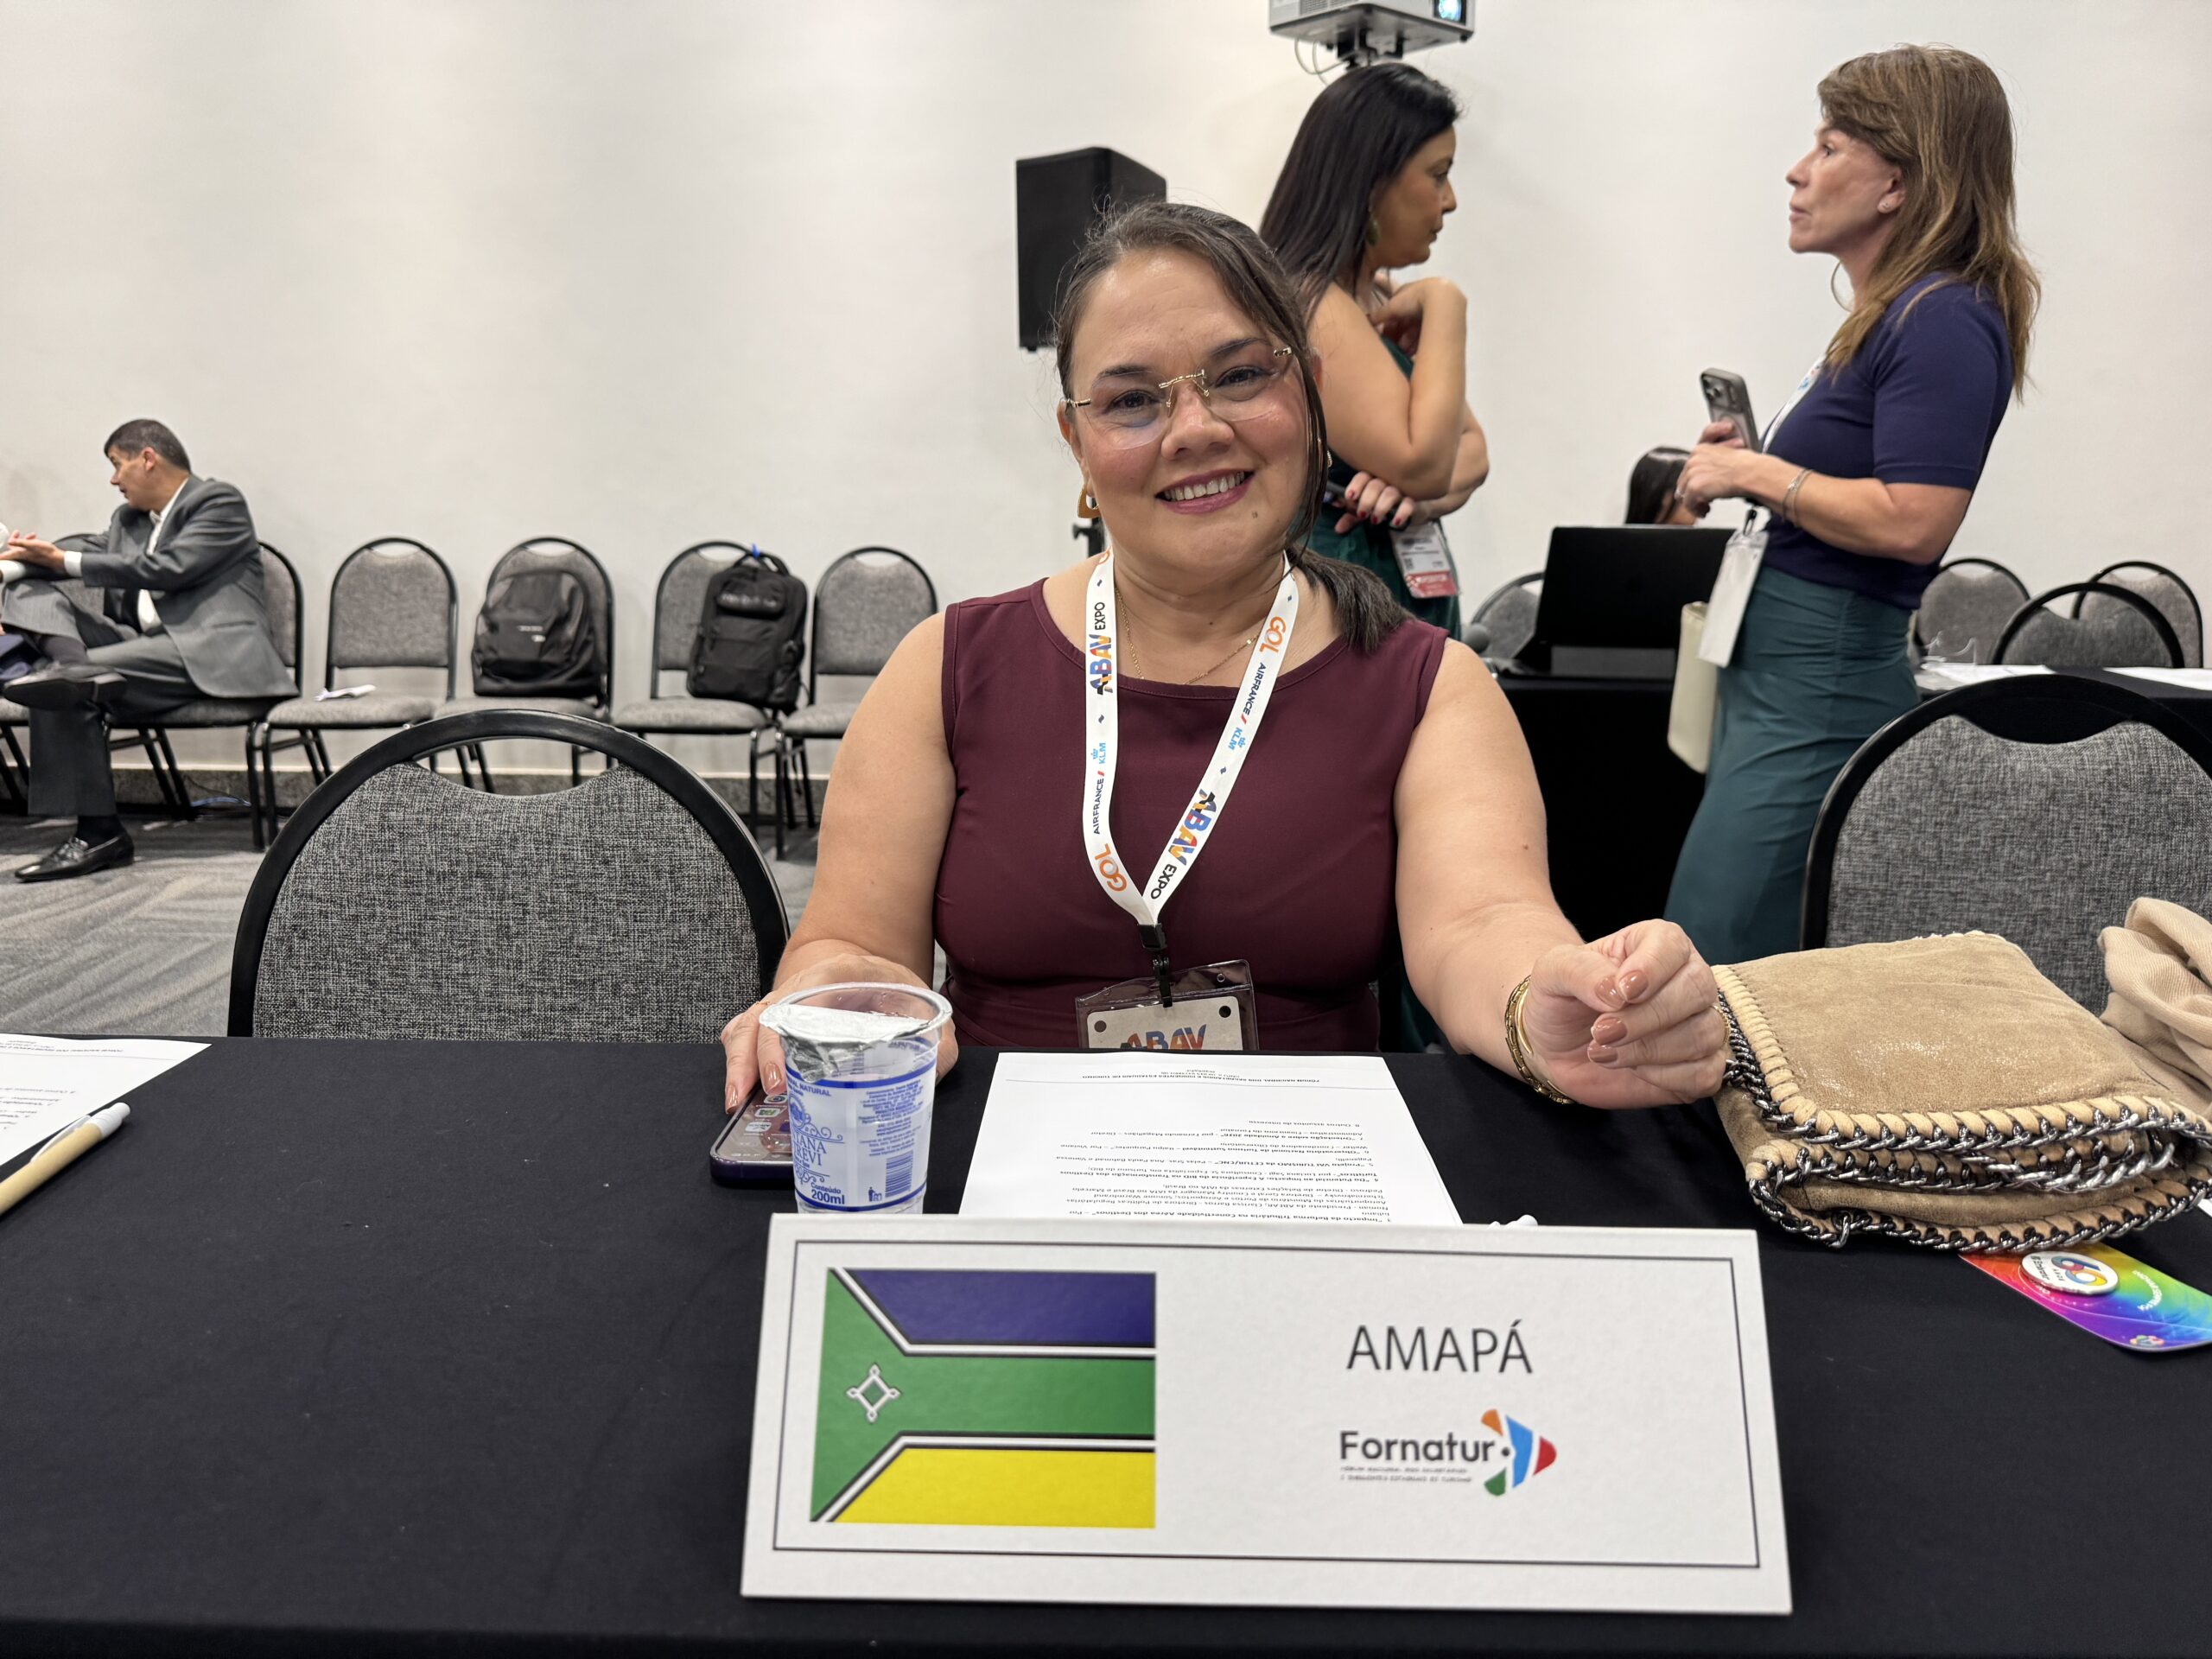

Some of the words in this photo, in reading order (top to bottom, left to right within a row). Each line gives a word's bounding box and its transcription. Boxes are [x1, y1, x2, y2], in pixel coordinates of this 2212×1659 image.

[1094, 602, 1105, 630] EXPO
[1260, 616, 1287, 653] GOL
[1089, 633, 1113, 696] ABAV
[1243, 662, 1267, 715] AIRFRANCE
[1228, 727, 1243, 750] KLM
[1093, 778, 1104, 835] AIRFRANCE
[1168, 789, 1217, 866] ABAV
[1095, 843, 1128, 892] GOL
[1151, 864, 1177, 899] EXPO
[799, 1083, 832, 1097] NATURAL
[810, 1182, 842, 1194] Conteúdo
[811, 1189, 845, 1205] 200ml
[1346, 1319, 1533, 1374] AMAPÁ
[1340, 1430, 1495, 1462] Fornatur
